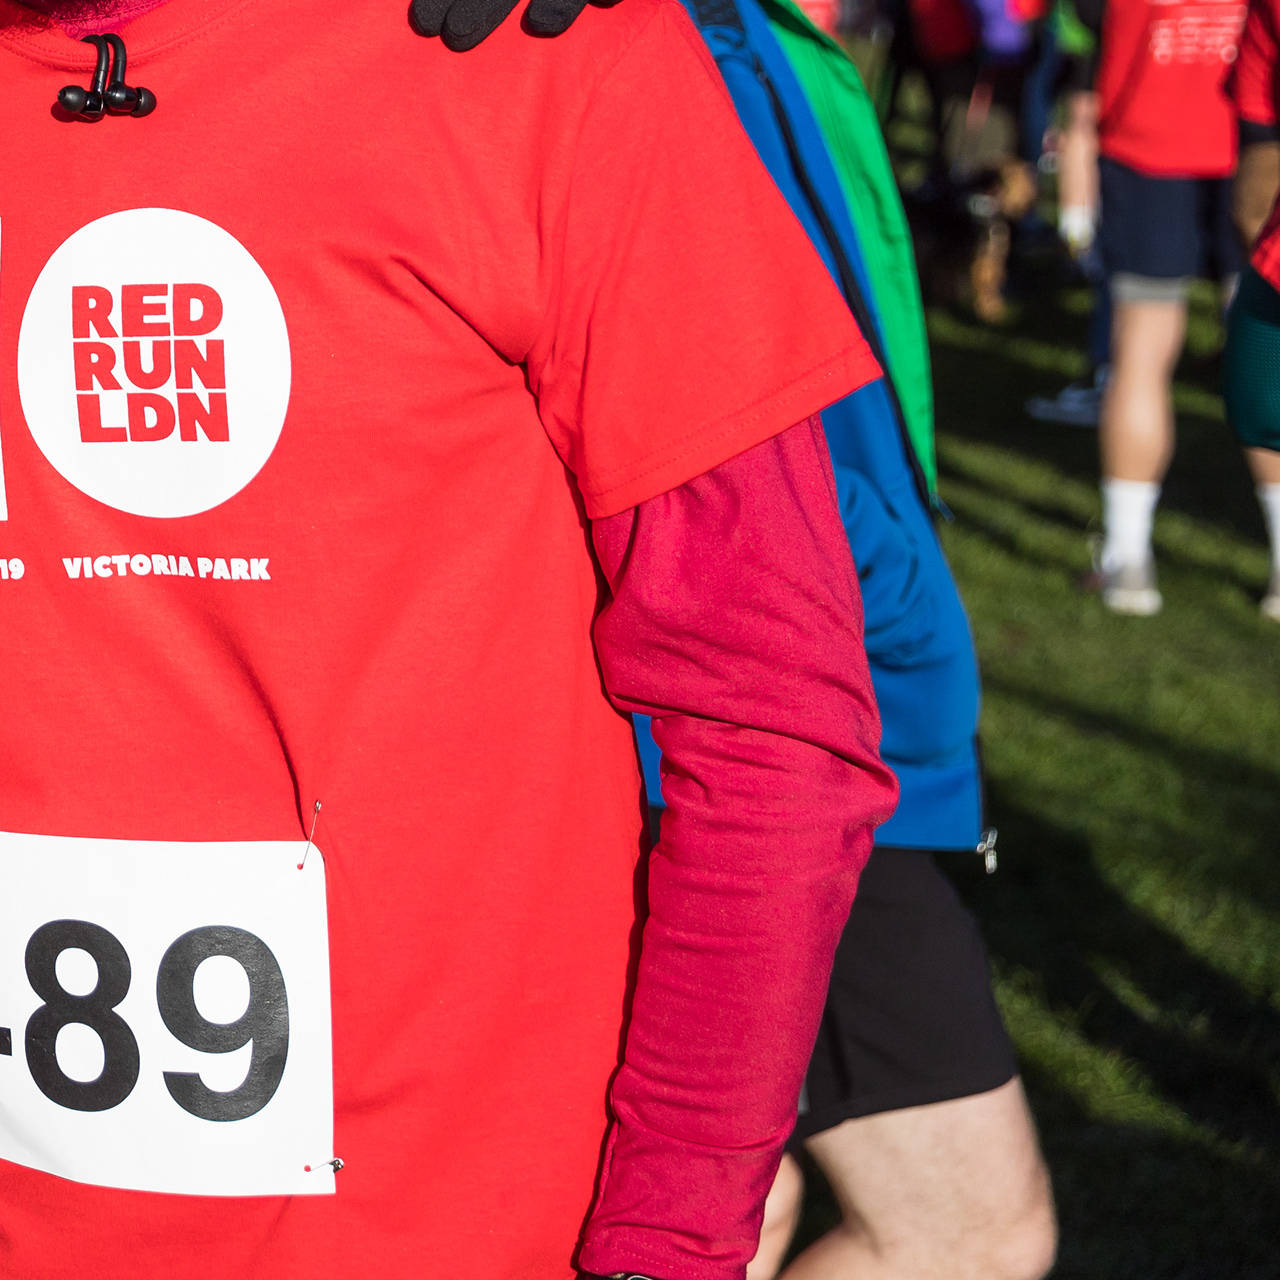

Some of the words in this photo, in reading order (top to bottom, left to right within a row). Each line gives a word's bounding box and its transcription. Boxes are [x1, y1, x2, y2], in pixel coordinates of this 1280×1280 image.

[71, 282, 224, 339] RED
[73, 338, 226, 391] RUN
[75, 391, 230, 443] LDN
[62, 554, 196, 580] VICTORIA
[198, 557, 271, 581] PARK
